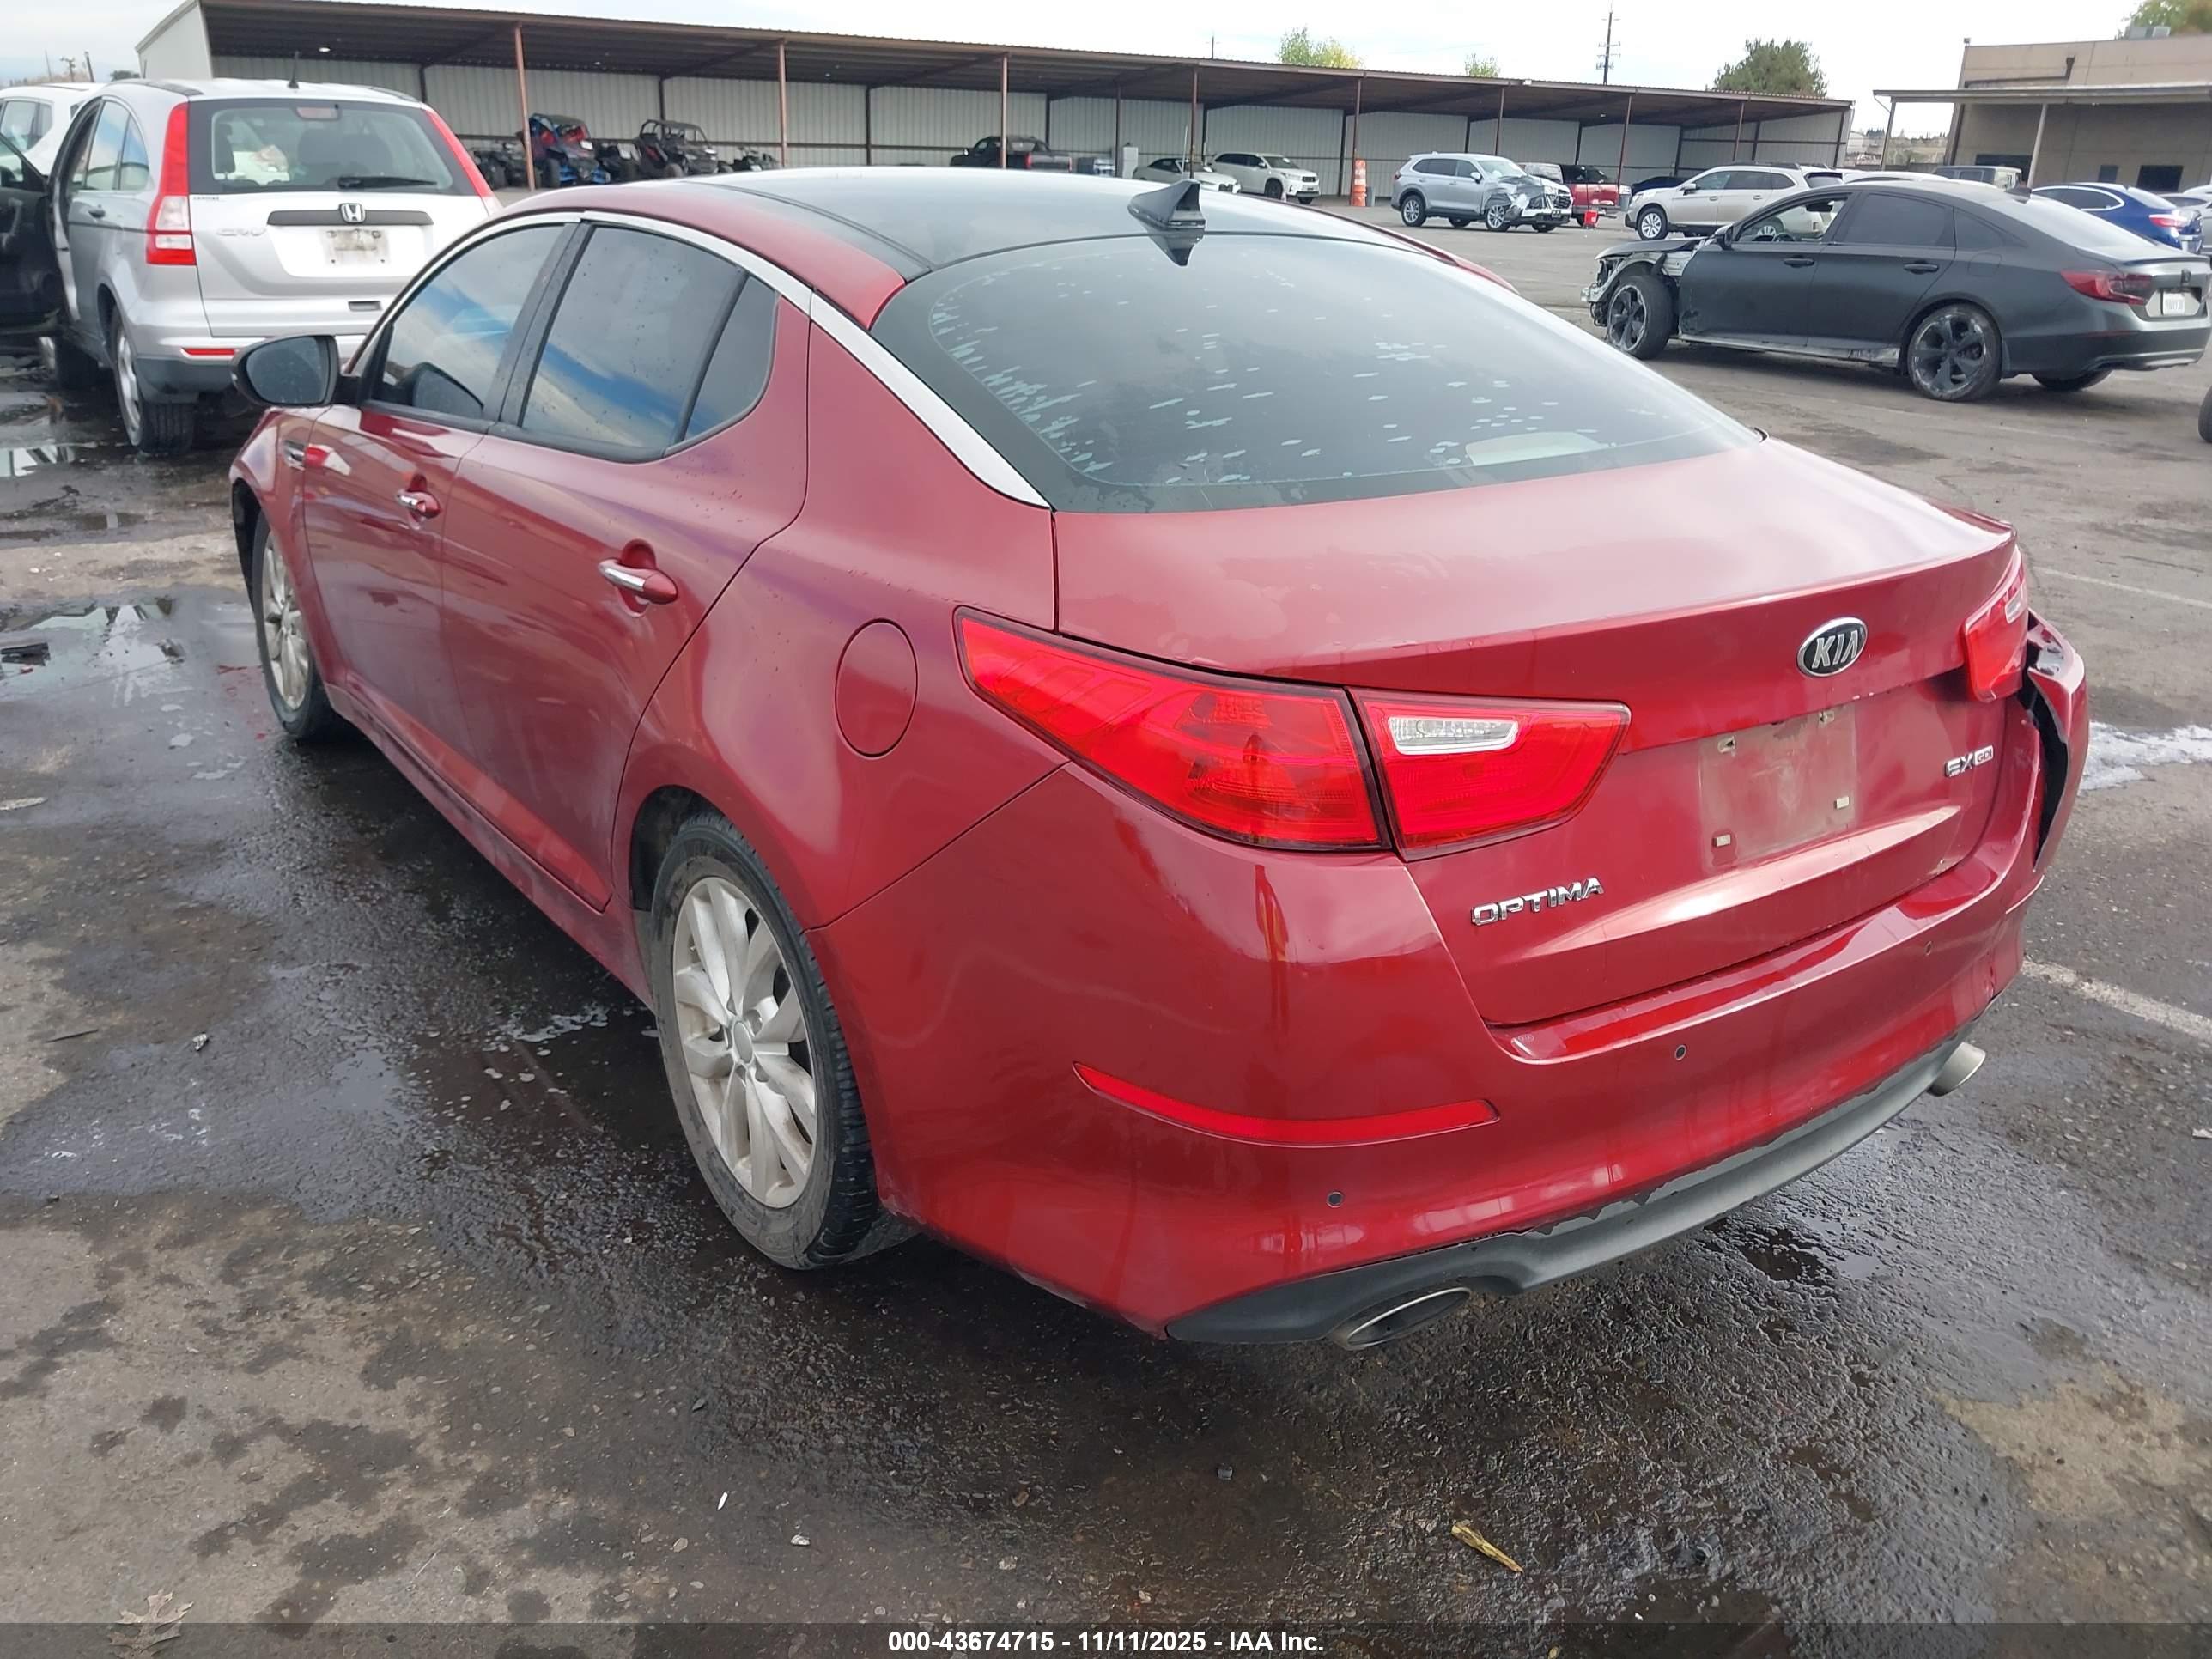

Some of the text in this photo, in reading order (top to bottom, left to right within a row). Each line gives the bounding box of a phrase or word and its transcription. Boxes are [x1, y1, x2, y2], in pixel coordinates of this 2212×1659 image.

[1811, 629, 1859, 669] KIA
[1944, 752, 1973, 777] EX
[1471, 876, 1604, 926] OPTIMA
